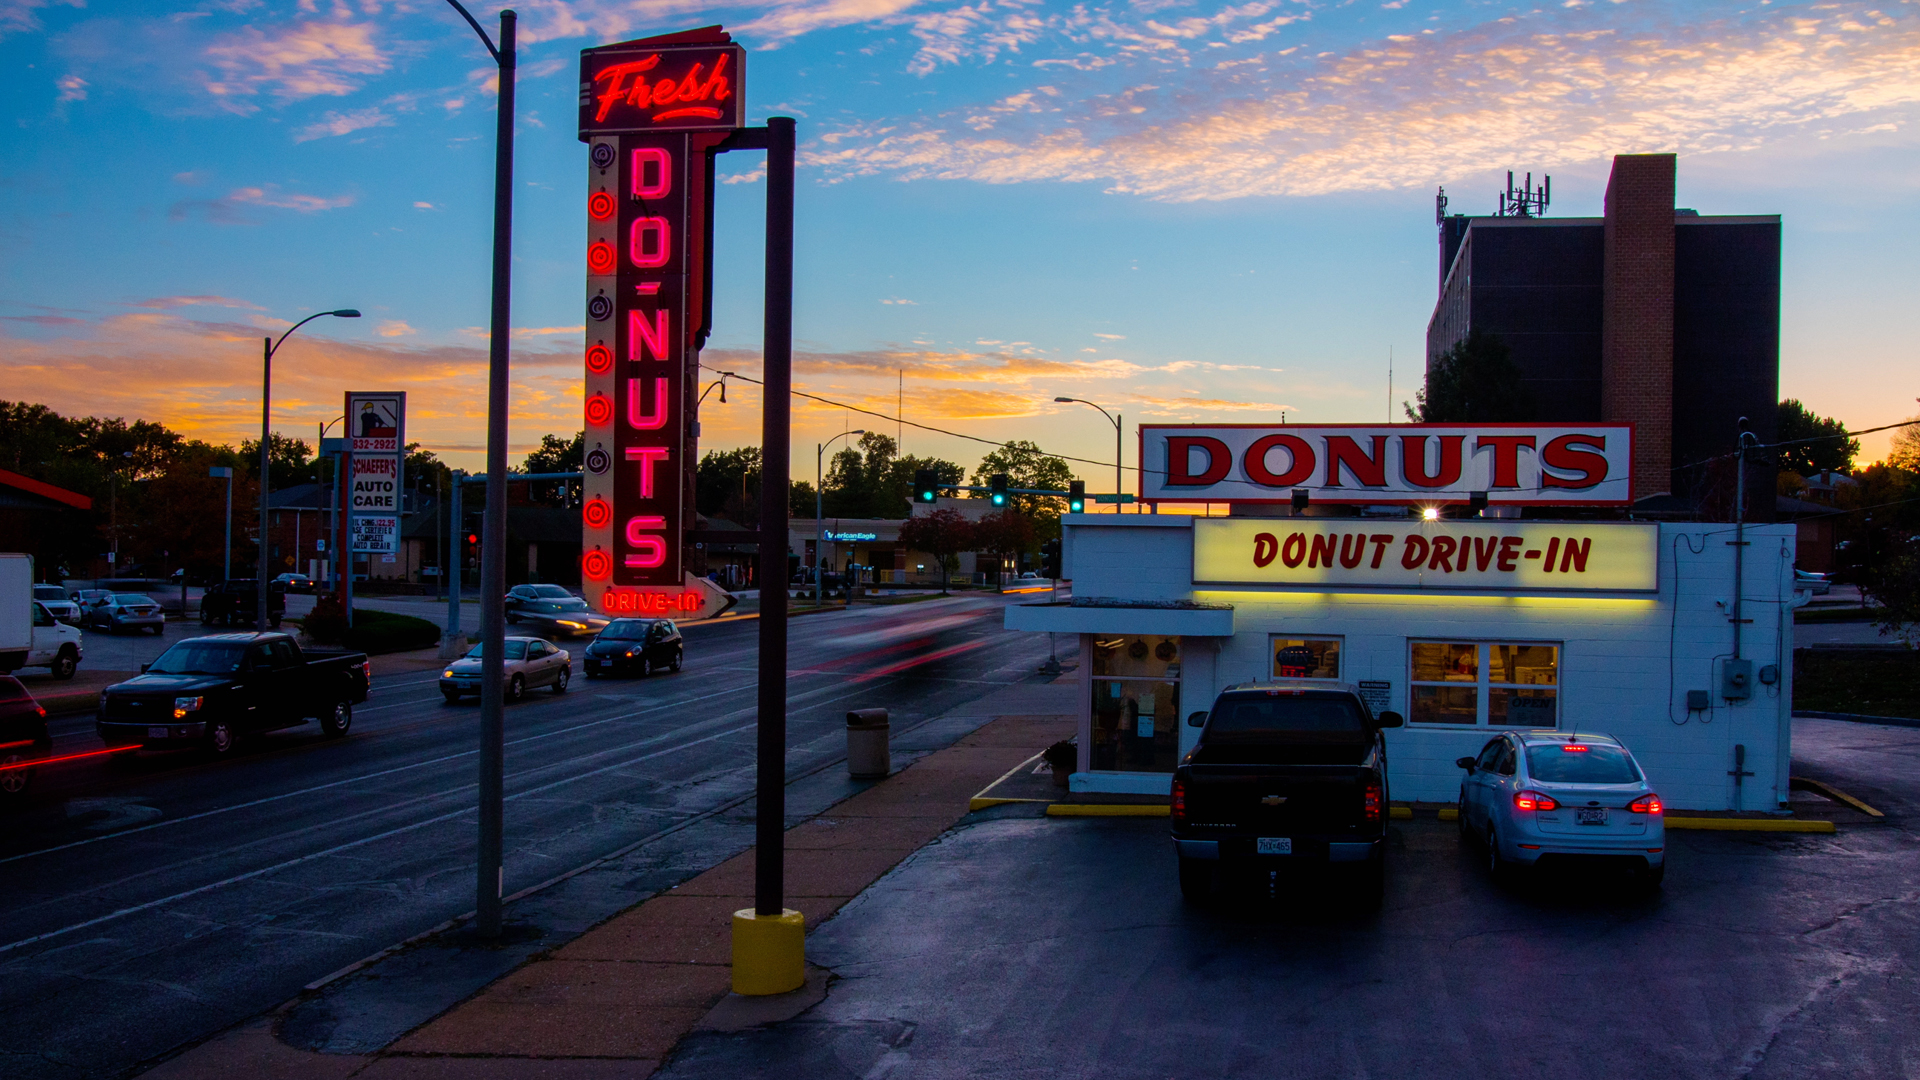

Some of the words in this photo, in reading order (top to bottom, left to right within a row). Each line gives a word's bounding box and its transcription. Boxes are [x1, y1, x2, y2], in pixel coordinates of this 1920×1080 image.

[594, 52, 731, 123] Fresh
[353, 439, 396, 450] 832-2922
[353, 459, 397, 479] SCHAEFER'S
[1163, 433, 1609, 491] DONUTS
[354, 481, 393, 492] AUTO
[353, 495, 393, 507] CARE
[1253, 532, 1394, 569] DONUT
[1401, 534, 1592, 573] DRIVE-IN
[604, 592, 699, 611] DRIVE-IN
[1512, 698, 1551, 708] OPEN
